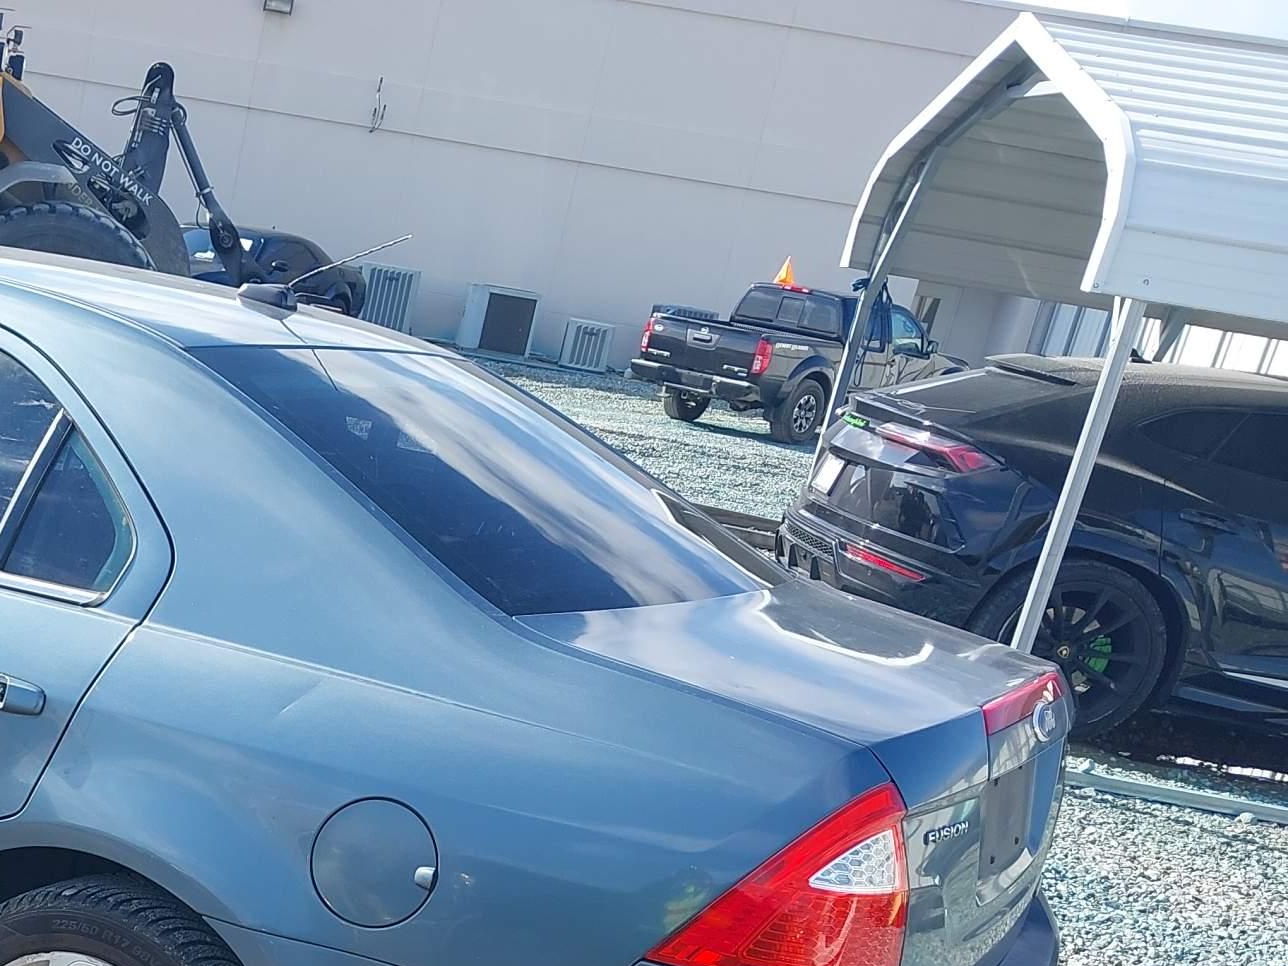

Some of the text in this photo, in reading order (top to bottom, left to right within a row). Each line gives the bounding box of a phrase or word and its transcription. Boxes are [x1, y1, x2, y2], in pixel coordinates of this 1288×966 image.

[71, 137, 153, 206] DO NOT WALK
[924, 820, 969, 845] FUSION
